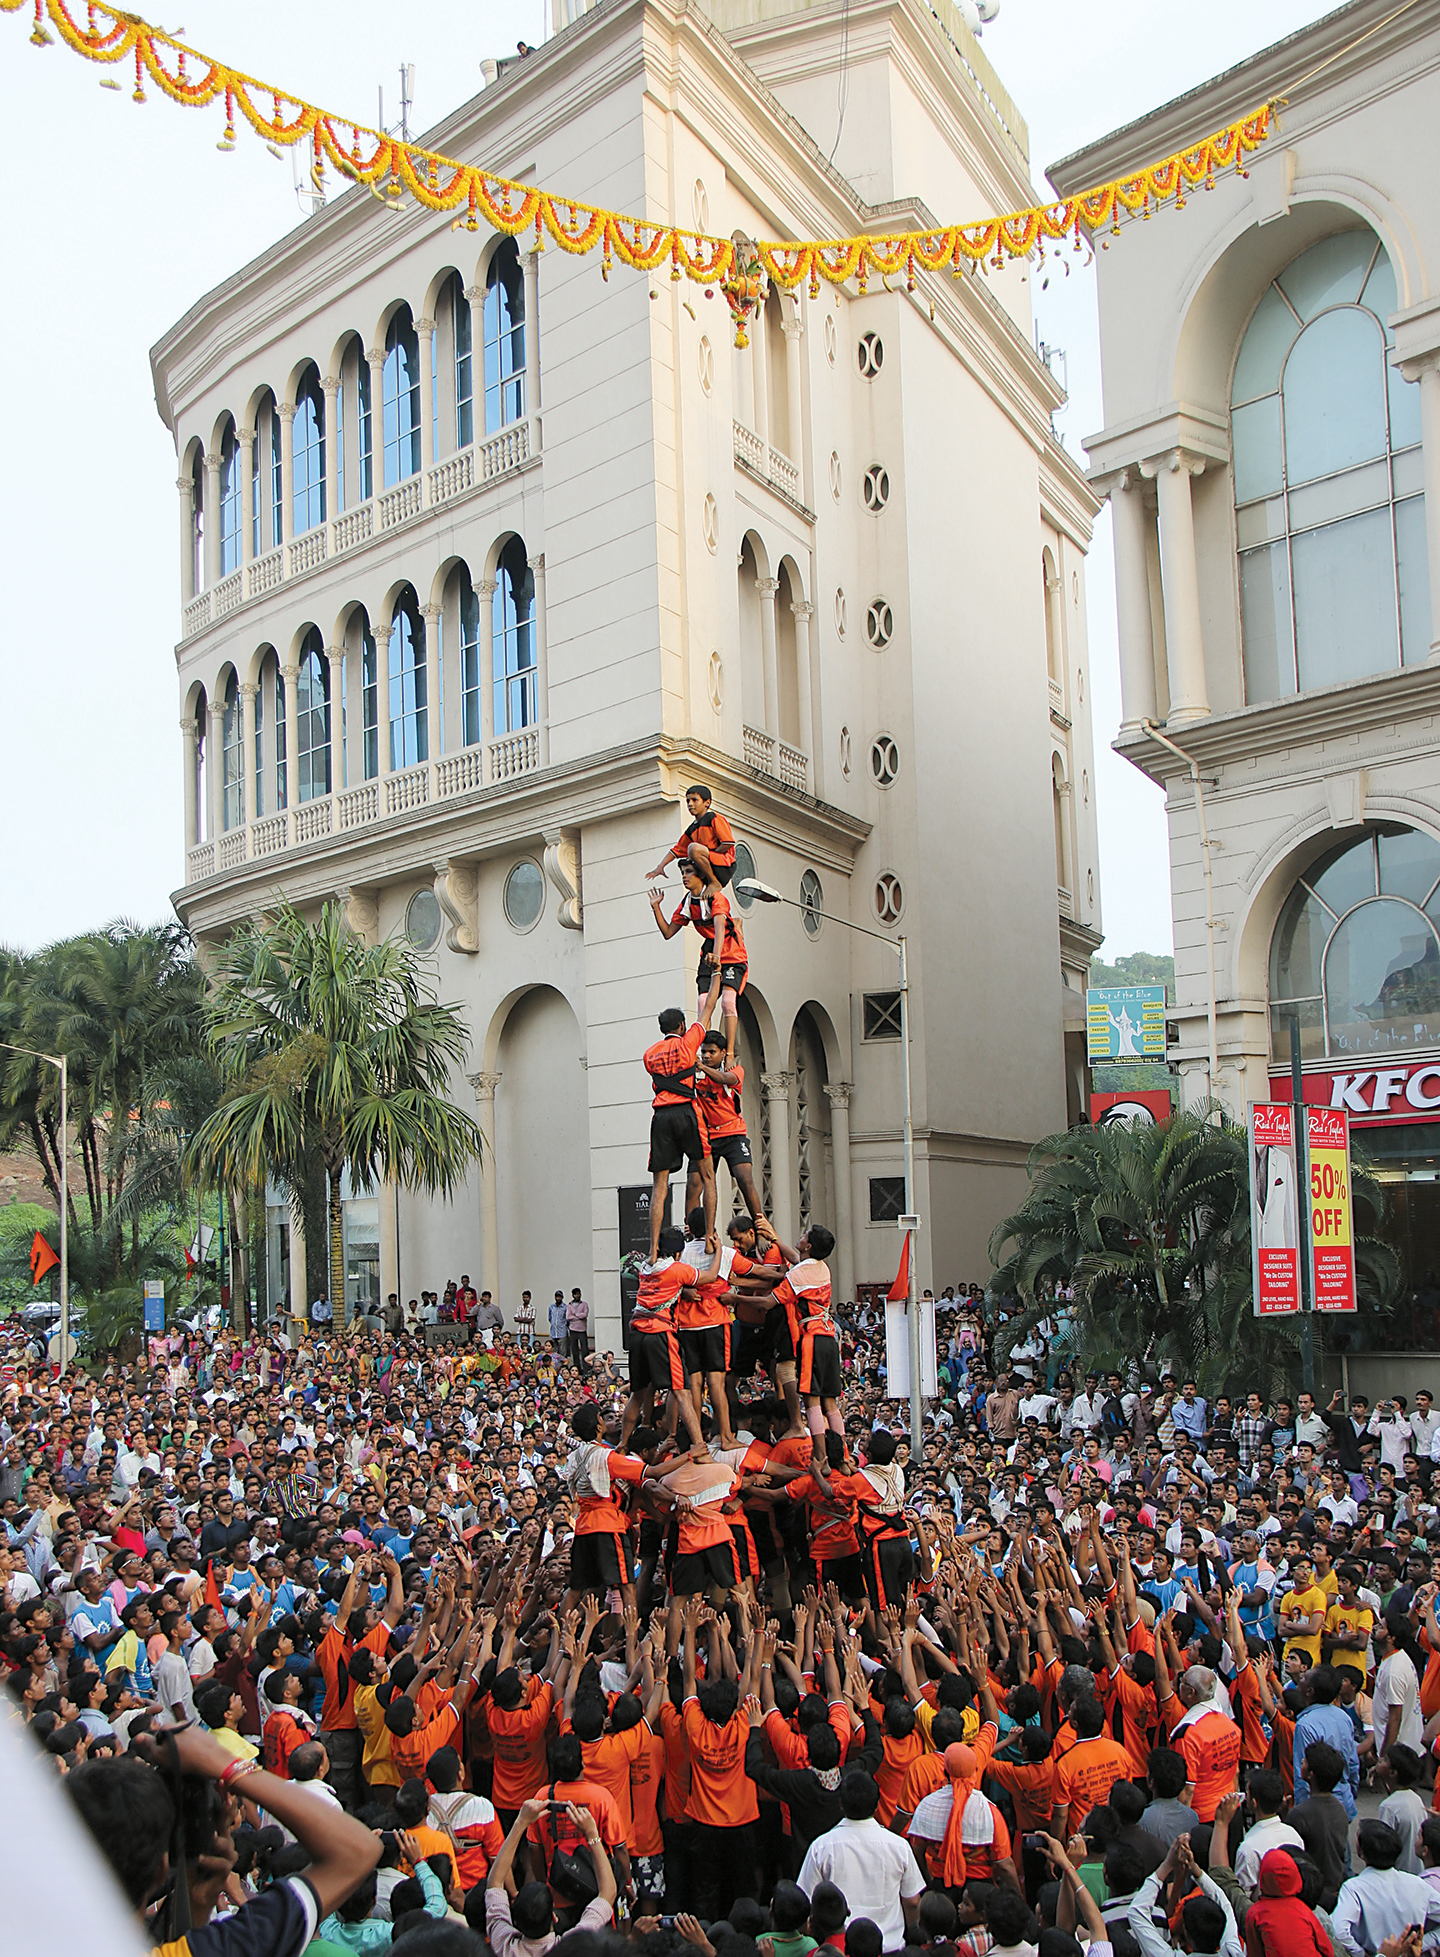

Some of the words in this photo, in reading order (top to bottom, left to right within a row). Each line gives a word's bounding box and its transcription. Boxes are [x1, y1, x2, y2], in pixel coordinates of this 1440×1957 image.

[1114, 991, 1120, 1000] of
[1123, 990, 1133, 999] the
[1136, 989, 1151, 998] Blue
[1369, 1029, 1380, 1047] of
[1386, 1027, 1408, 1047] the
[1330, 1065, 1440, 1113] KFC
[1253, 1112, 1270, 1130] Reid
[1274, 1114, 1291, 1136] Taylor
[1308, 1116, 1324, 1133] Reid
[1328, 1117, 1345, 1140] Taylor
[1311, 1163, 1346, 1200] 50%
[1312, 1208, 1342, 1236] OFF
